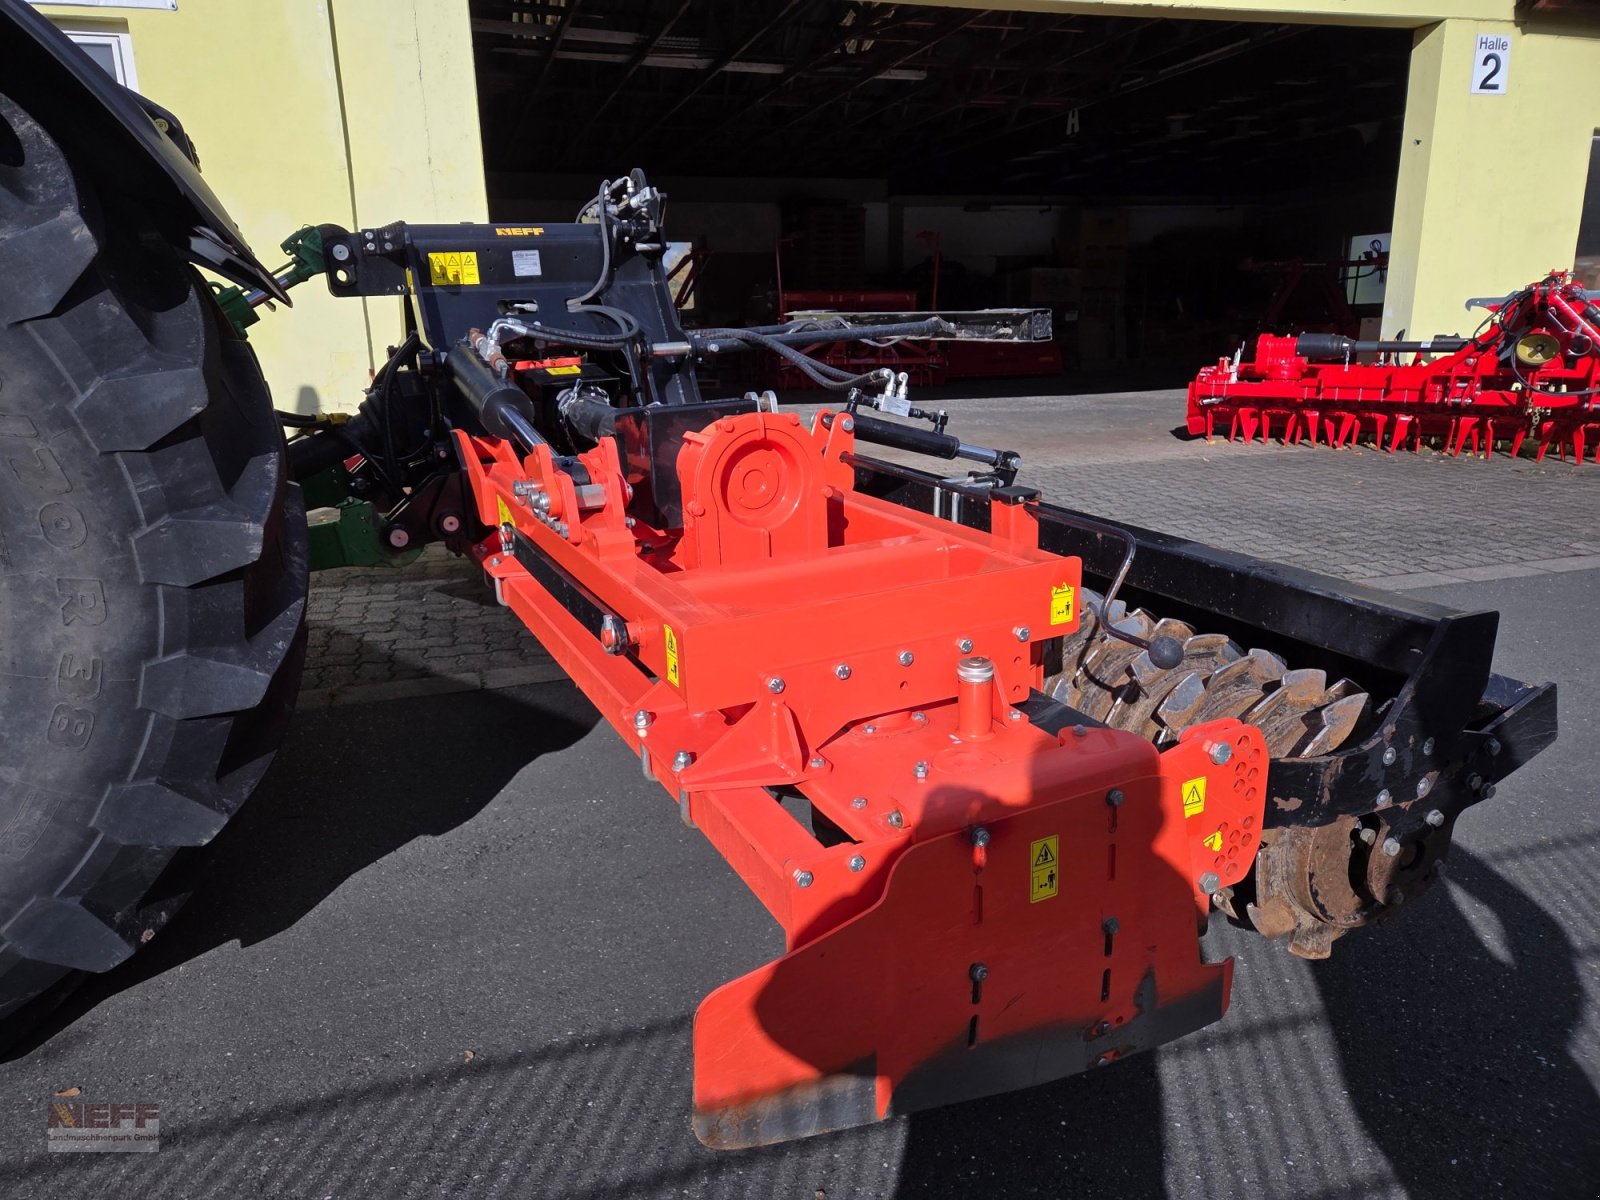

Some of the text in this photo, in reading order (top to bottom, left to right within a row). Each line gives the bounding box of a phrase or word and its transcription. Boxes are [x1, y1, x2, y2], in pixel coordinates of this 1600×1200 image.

[1479, 36, 1508, 51] Halle
[1479, 52, 1502, 90] 2
[495, 227, 545, 236] NEFF
